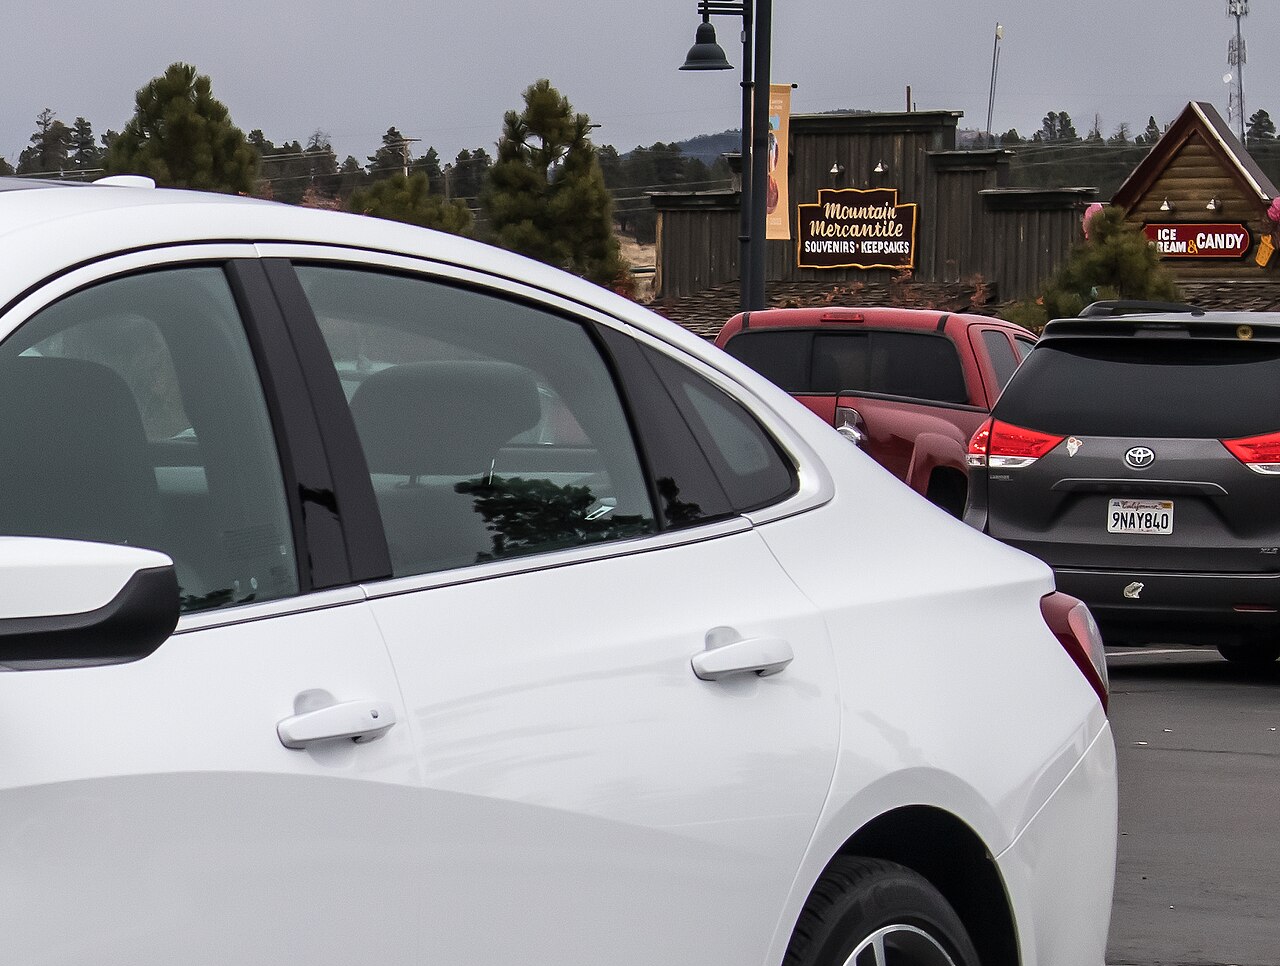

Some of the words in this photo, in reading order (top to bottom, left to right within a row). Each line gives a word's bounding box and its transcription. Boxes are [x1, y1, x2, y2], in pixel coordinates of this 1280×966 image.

[823, 202, 897, 220] Mountain
[809, 220, 903, 238] Mercantile
[1157, 229, 1177, 241] ICE
[805, 241, 855, 254] SOUVENIRS
[861, 241, 910, 254] KEEPSAKES
[1187, 239, 1198, 254] &
[1196, 233, 1244, 249] CANDY
[1112, 512, 1169, 530] 9NAY840
